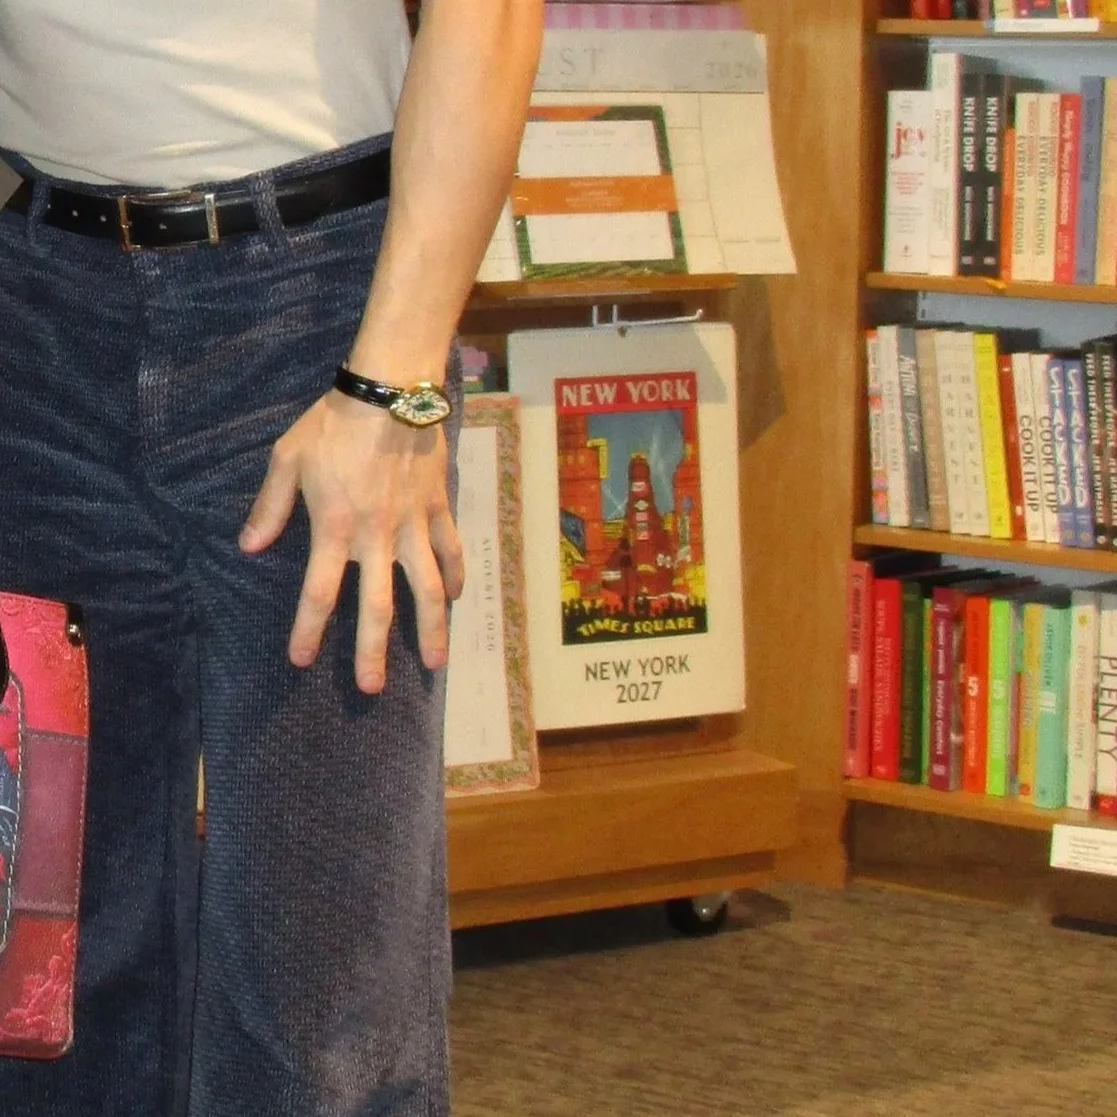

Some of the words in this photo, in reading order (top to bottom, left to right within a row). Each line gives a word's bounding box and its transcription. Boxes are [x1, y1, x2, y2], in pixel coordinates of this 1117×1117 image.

[963, 97, 976, 133] KNIFE
[986, 97, 998, 133] KNIFE
[963, 136, 975, 173] DROP
[985, 136, 997, 172] DROP
[1015, 135, 1026, 193] EVERYDAY
[1038, 136, 1048, 194] EVERYDAY
[561, 381, 618, 408] NEW
[628, 377, 691, 405] YORK
[1019, 414, 1037, 468] COOK
[1038, 416, 1056, 468] COOK
[1049, 366, 1072, 506] STACKED
[1067, 368, 1090, 508] STACKED
[1023, 471, 1038, 486] IT
[1042, 472, 1058, 486] IT
[1025, 490, 1040, 513] UP
[1044, 492, 1059, 514] UP
[576, 618, 629, 637] TIMES
[634, 617, 695, 635] SQUARE
[585, 658, 629, 682] NEW
[638, 654, 691, 677] YORK
[616, 681, 662, 704] 2027
[1097, 655, 1117, 762] PLENTY
